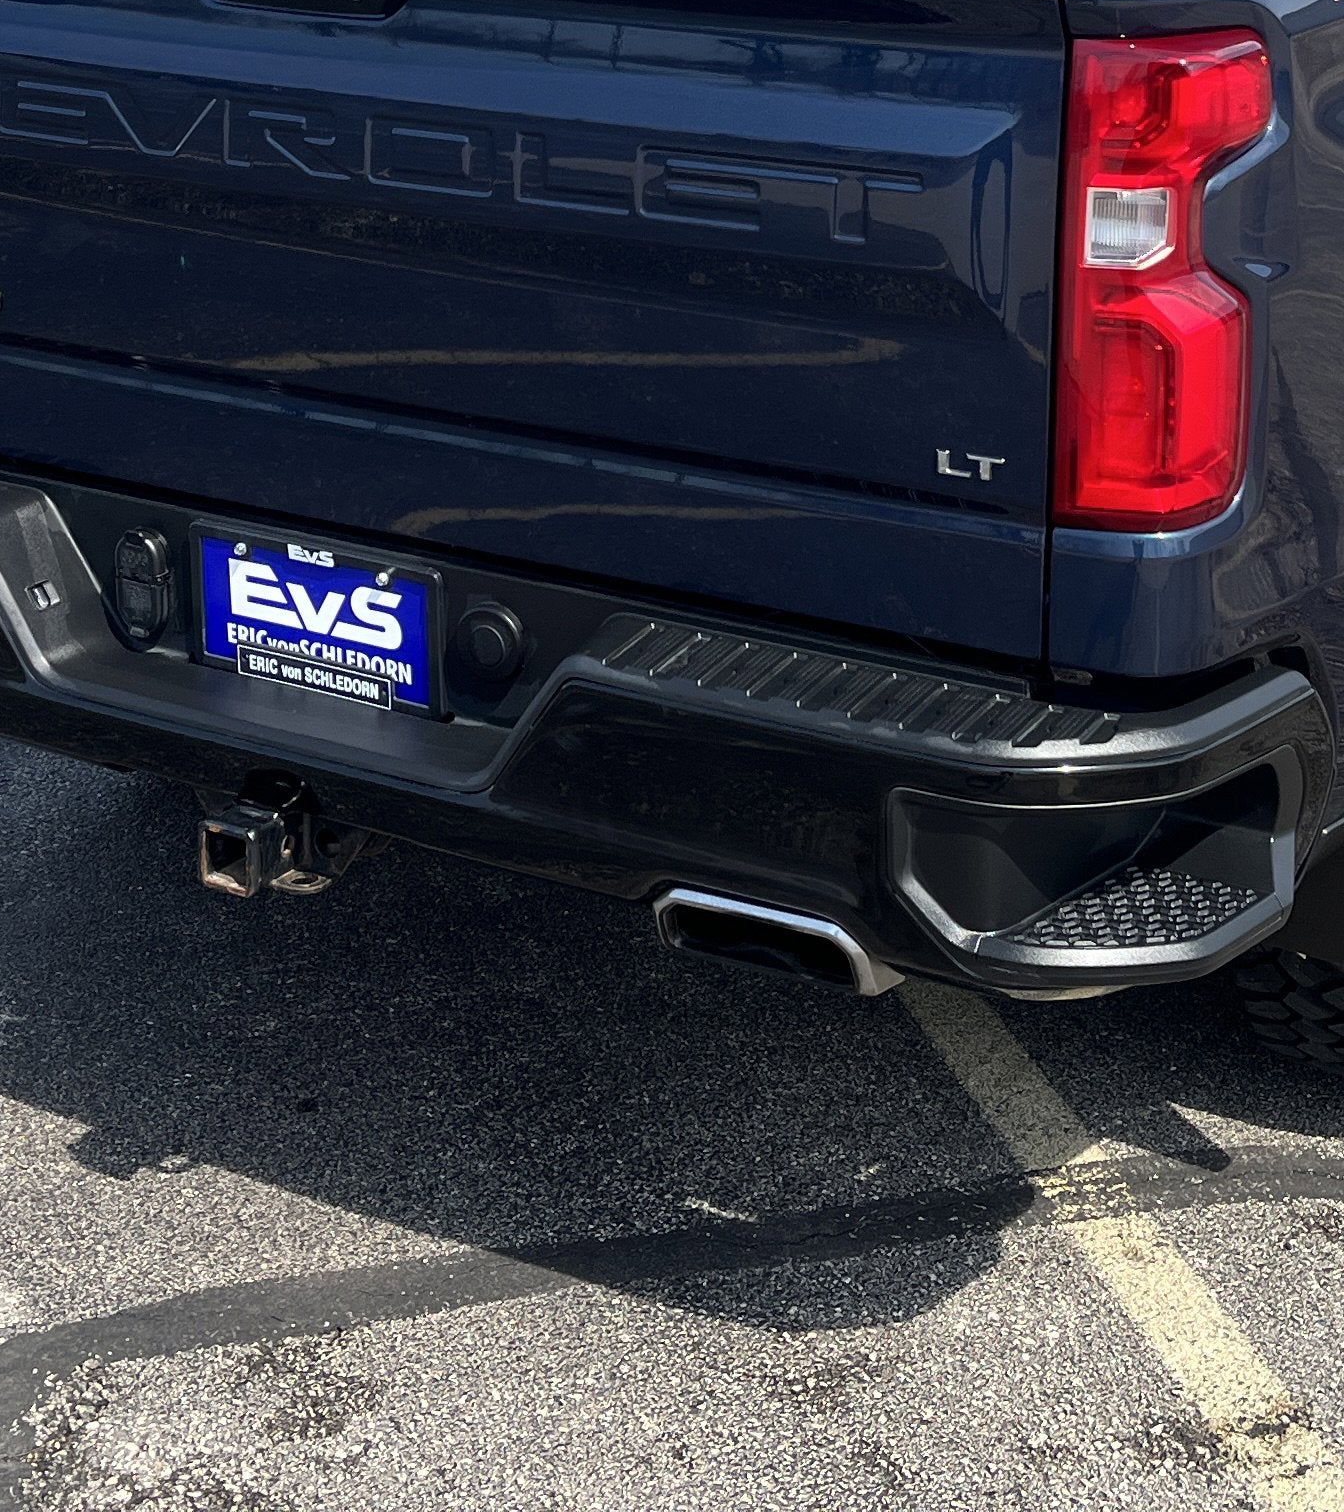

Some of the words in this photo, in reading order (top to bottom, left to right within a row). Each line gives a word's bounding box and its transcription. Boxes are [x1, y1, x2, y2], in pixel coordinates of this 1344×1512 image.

[936, 448, 1006, 481] LT
[249, 654, 278, 675] ERIC
[281, 664, 302, 681] von
[304, 666, 380, 700] SCHLEDORN
